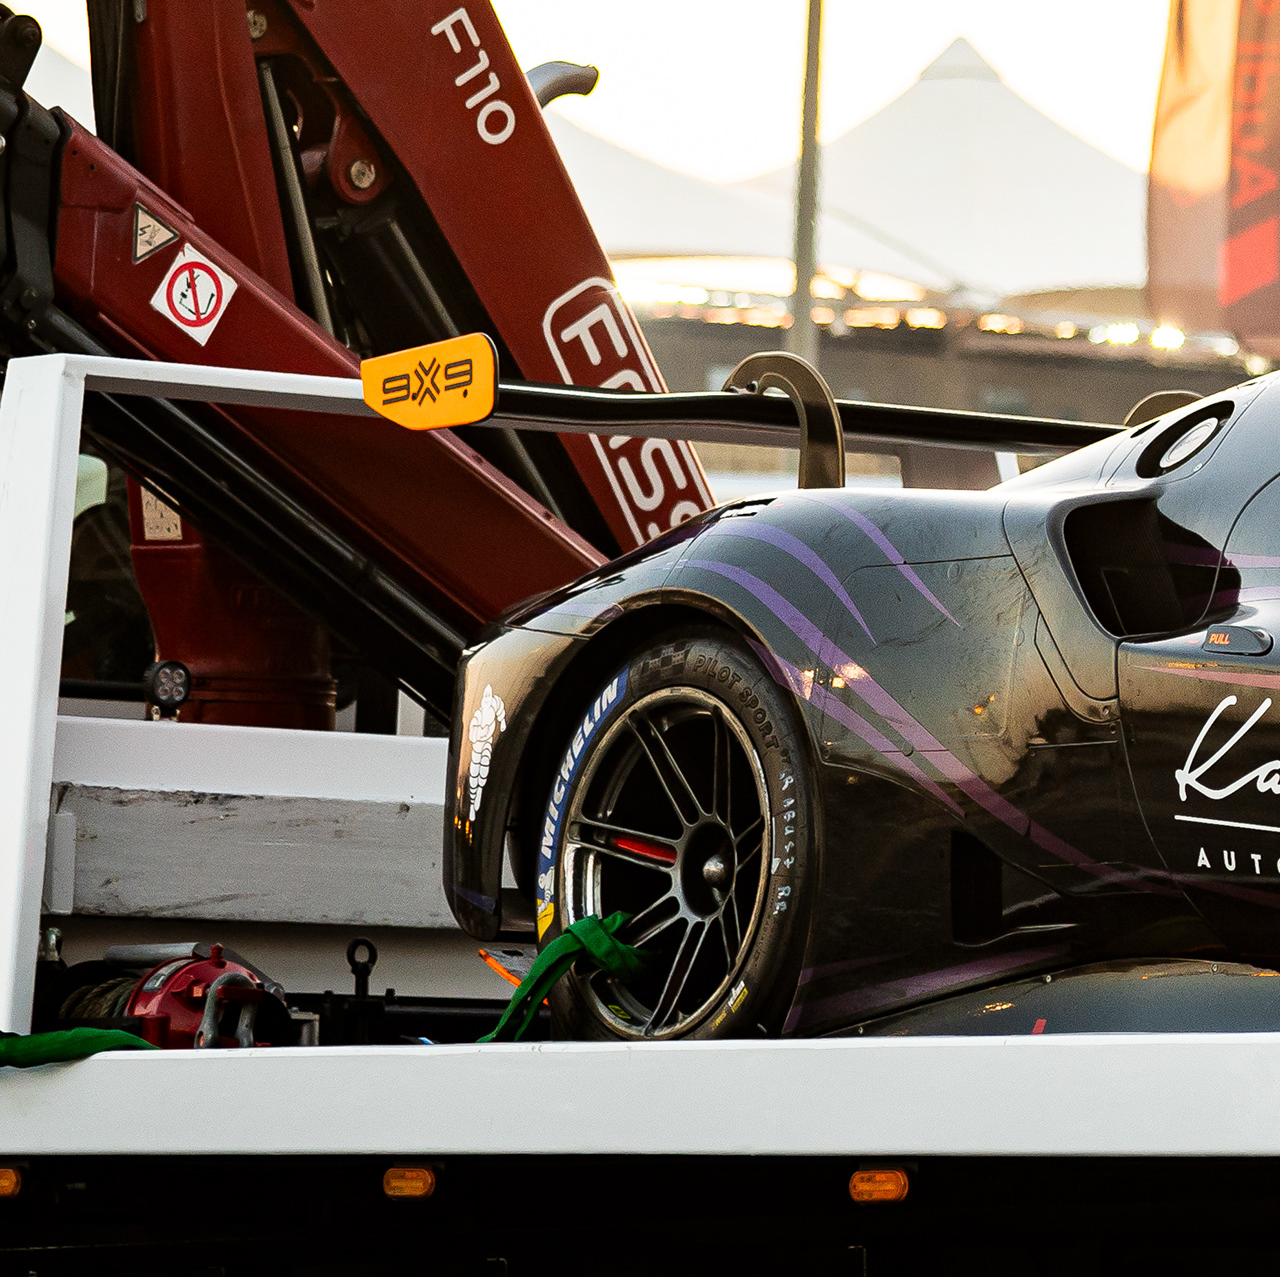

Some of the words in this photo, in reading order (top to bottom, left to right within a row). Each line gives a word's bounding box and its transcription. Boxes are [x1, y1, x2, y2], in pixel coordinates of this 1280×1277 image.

[430, 7, 516, 145] F110
[1208, 633, 1230, 645] PULL
[693, 654, 742, 689] PILOT
[740, 686, 779, 749] SPORT
[541, 677, 618, 860] MICHELIN
